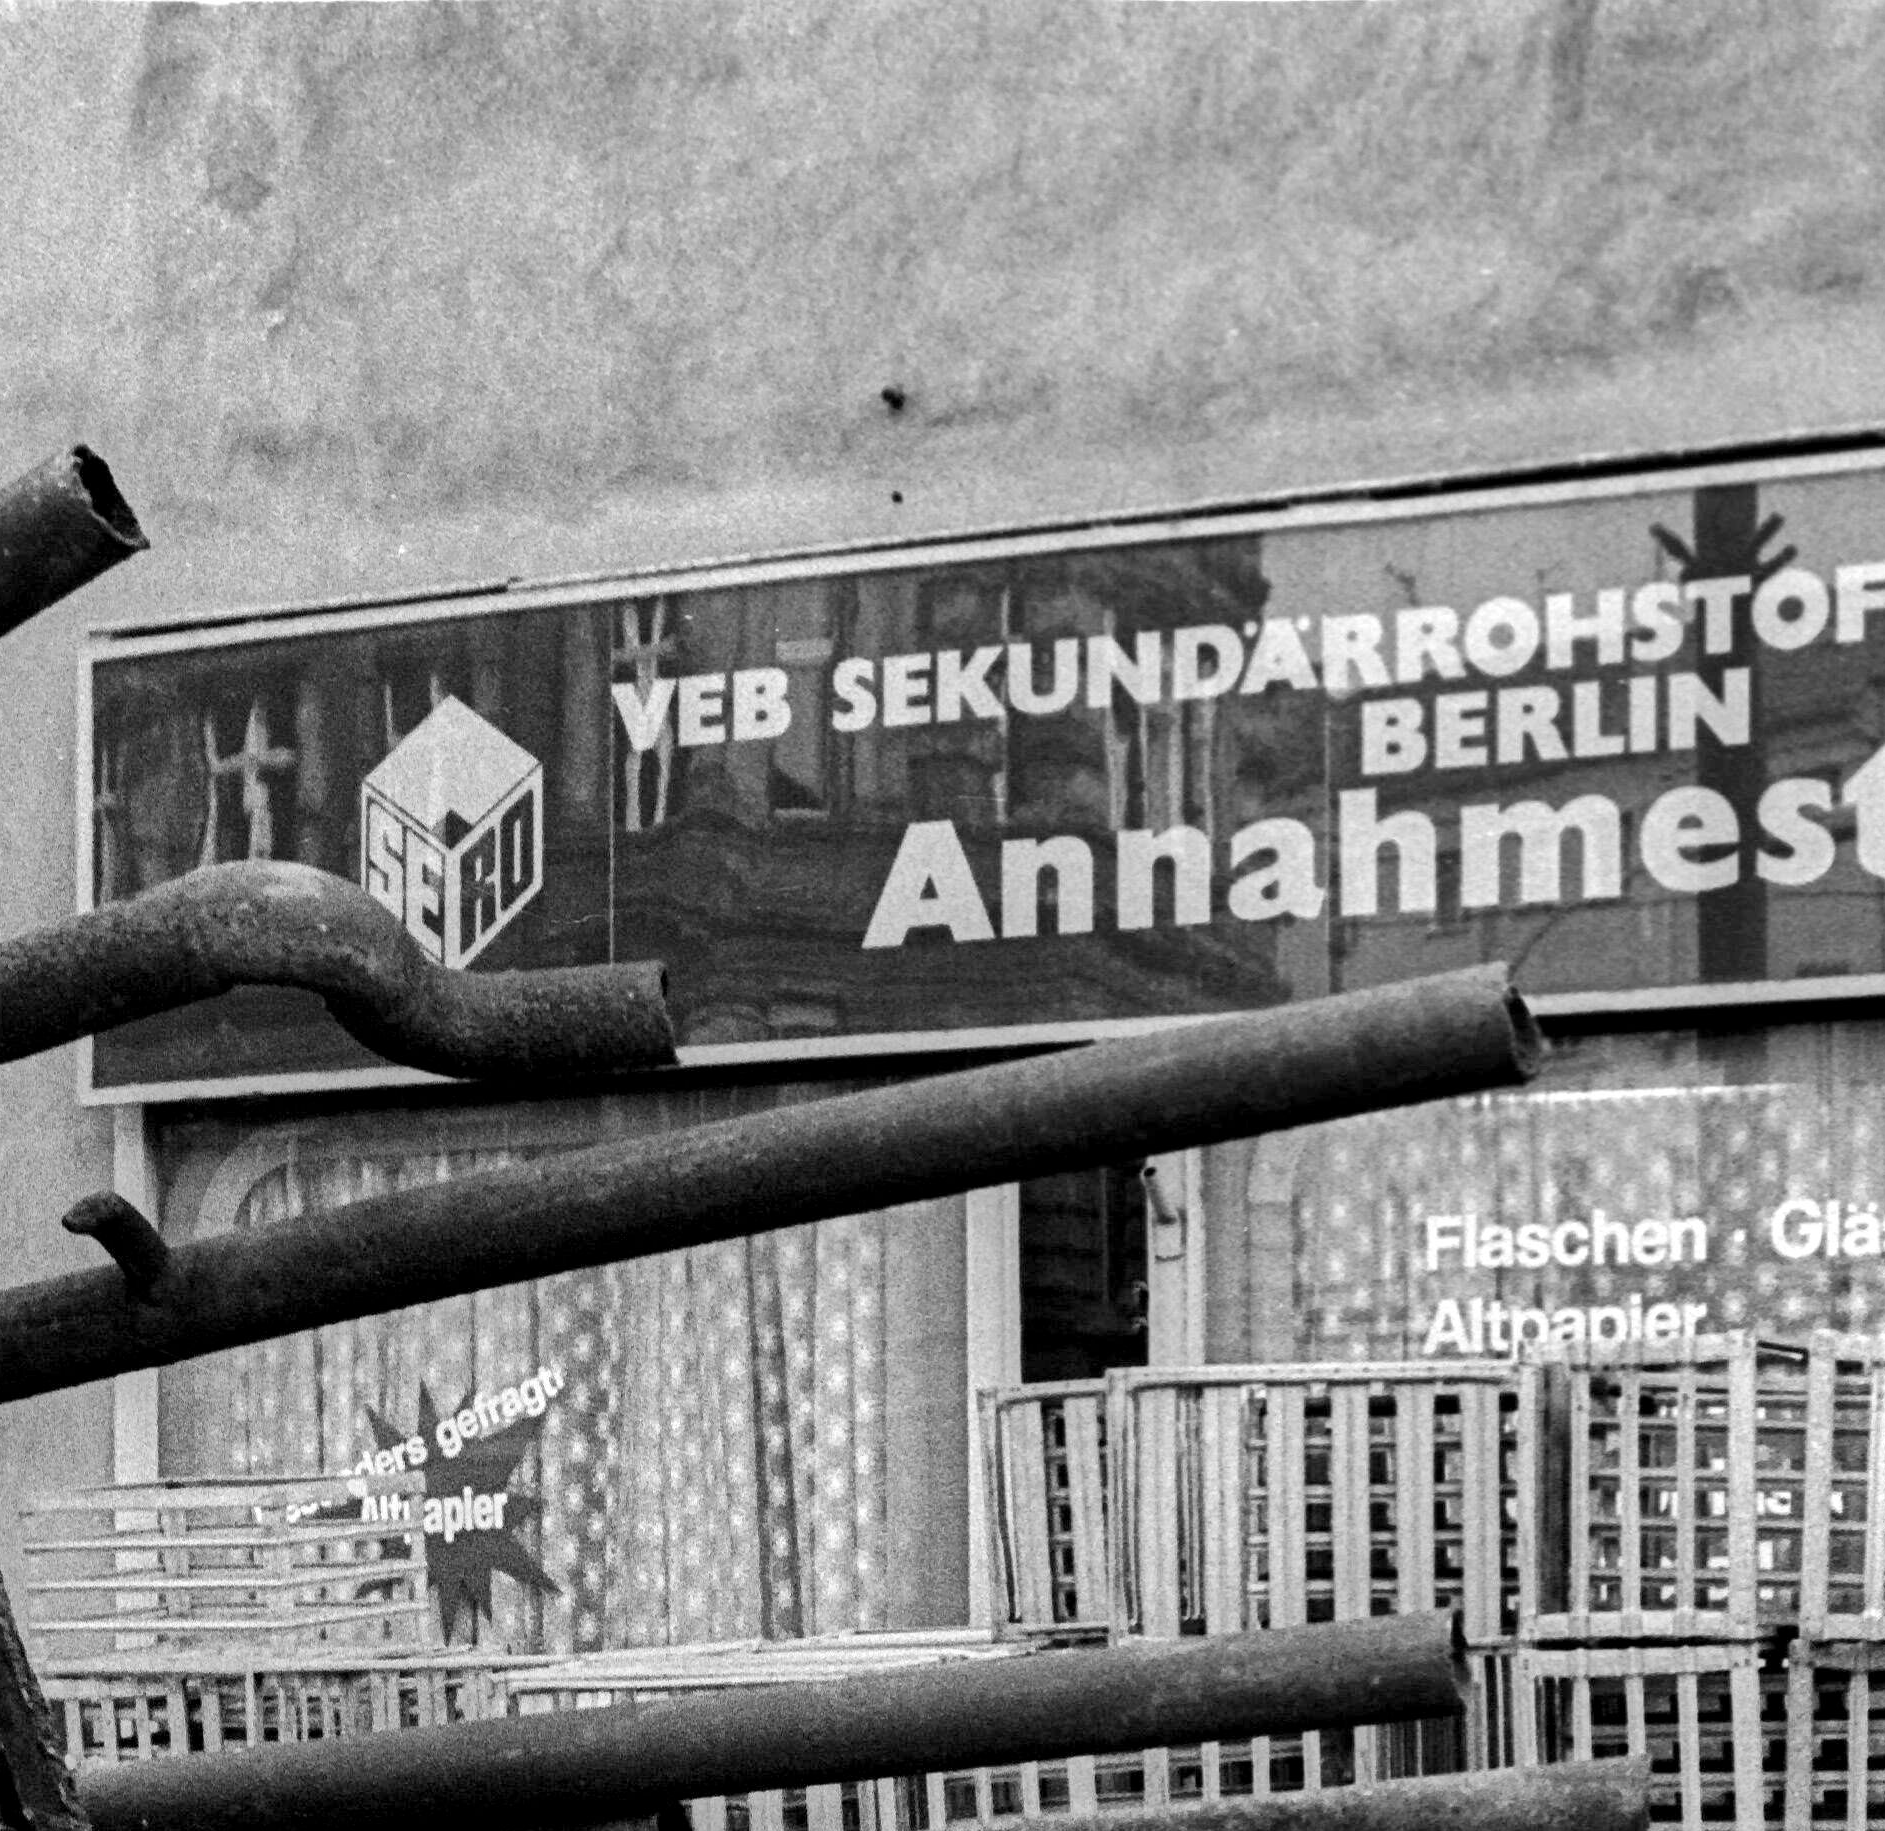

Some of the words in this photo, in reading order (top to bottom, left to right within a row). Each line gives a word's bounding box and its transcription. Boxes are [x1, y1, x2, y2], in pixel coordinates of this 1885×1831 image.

[613, 666, 792, 753] VEB
[1361, 667, 1752, 775] BERLIN
[1425, 1209, 1708, 1272] Flaschen
[1422, 1294, 1708, 1356] Altpapier
